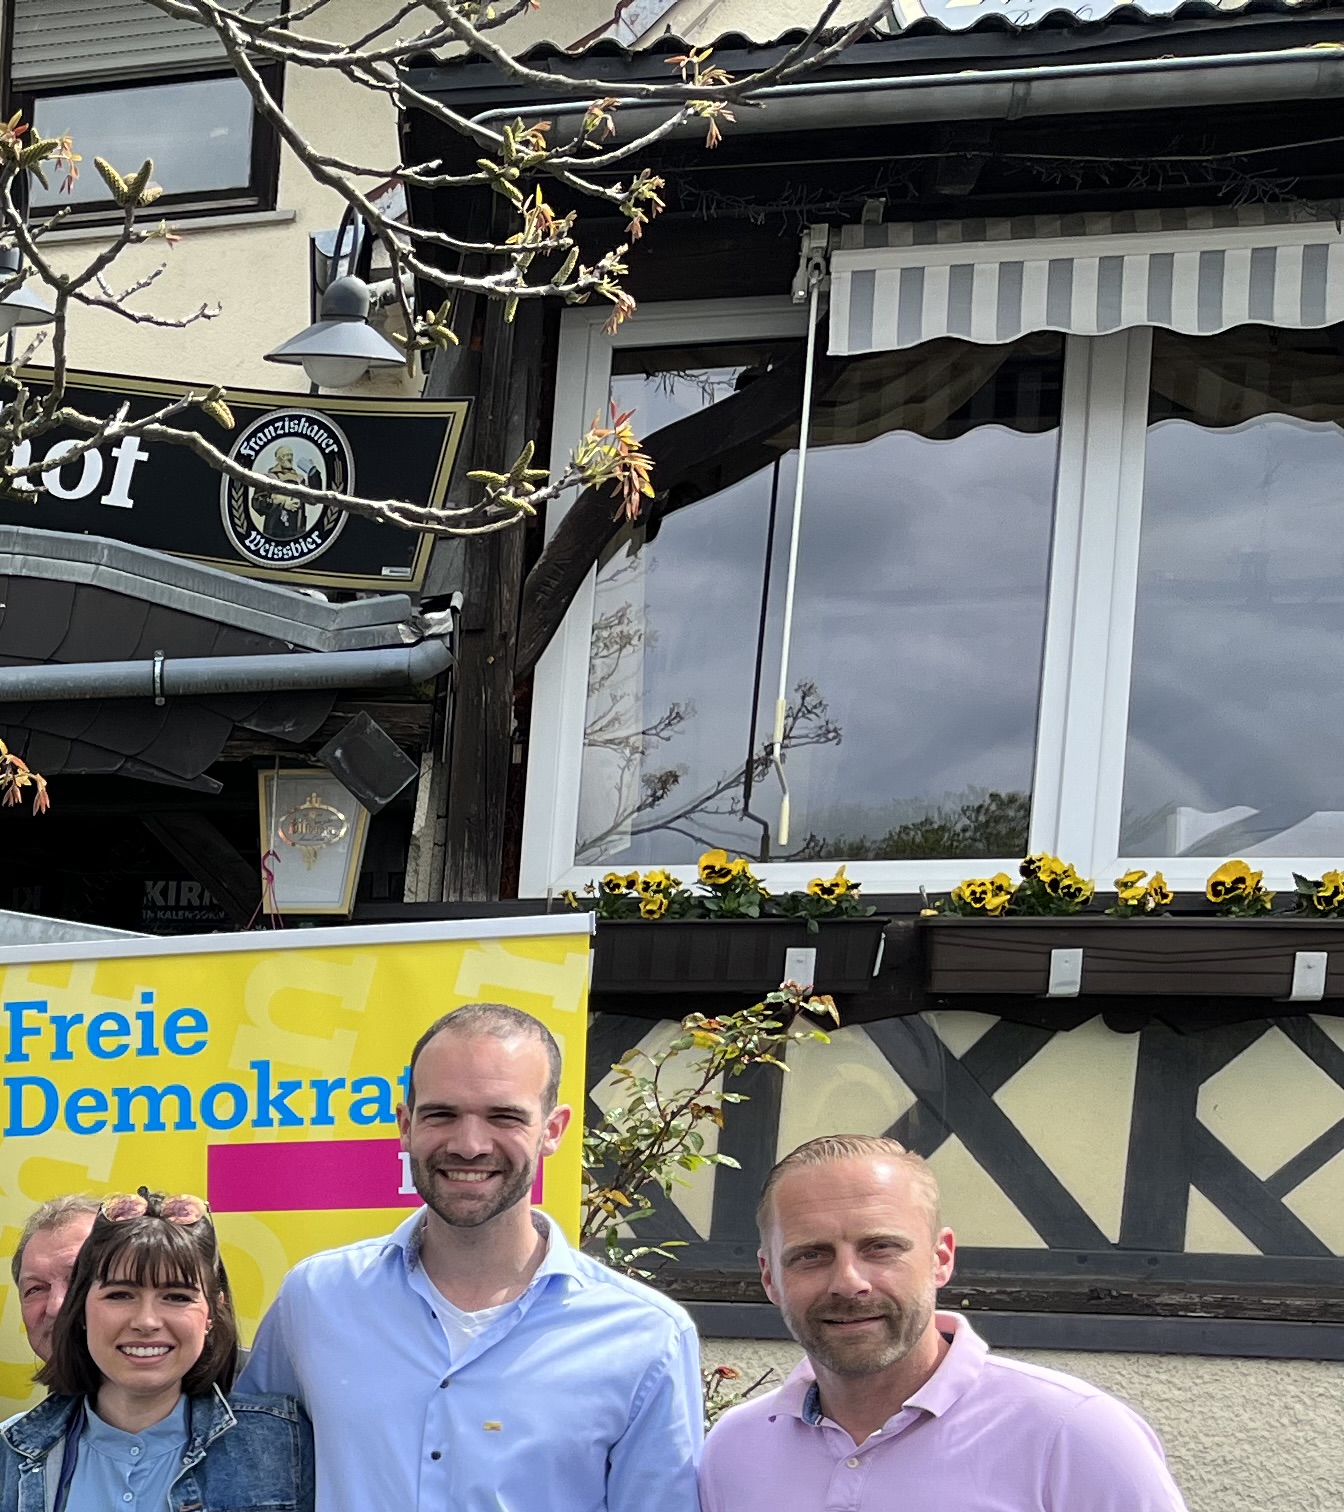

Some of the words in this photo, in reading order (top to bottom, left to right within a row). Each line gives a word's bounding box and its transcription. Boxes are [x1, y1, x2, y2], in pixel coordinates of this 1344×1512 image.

[240, 417, 339, 460] Franziskaner
[244, 530, 322, 559] Weissbier
[3, 991, 209, 1063] Freie
